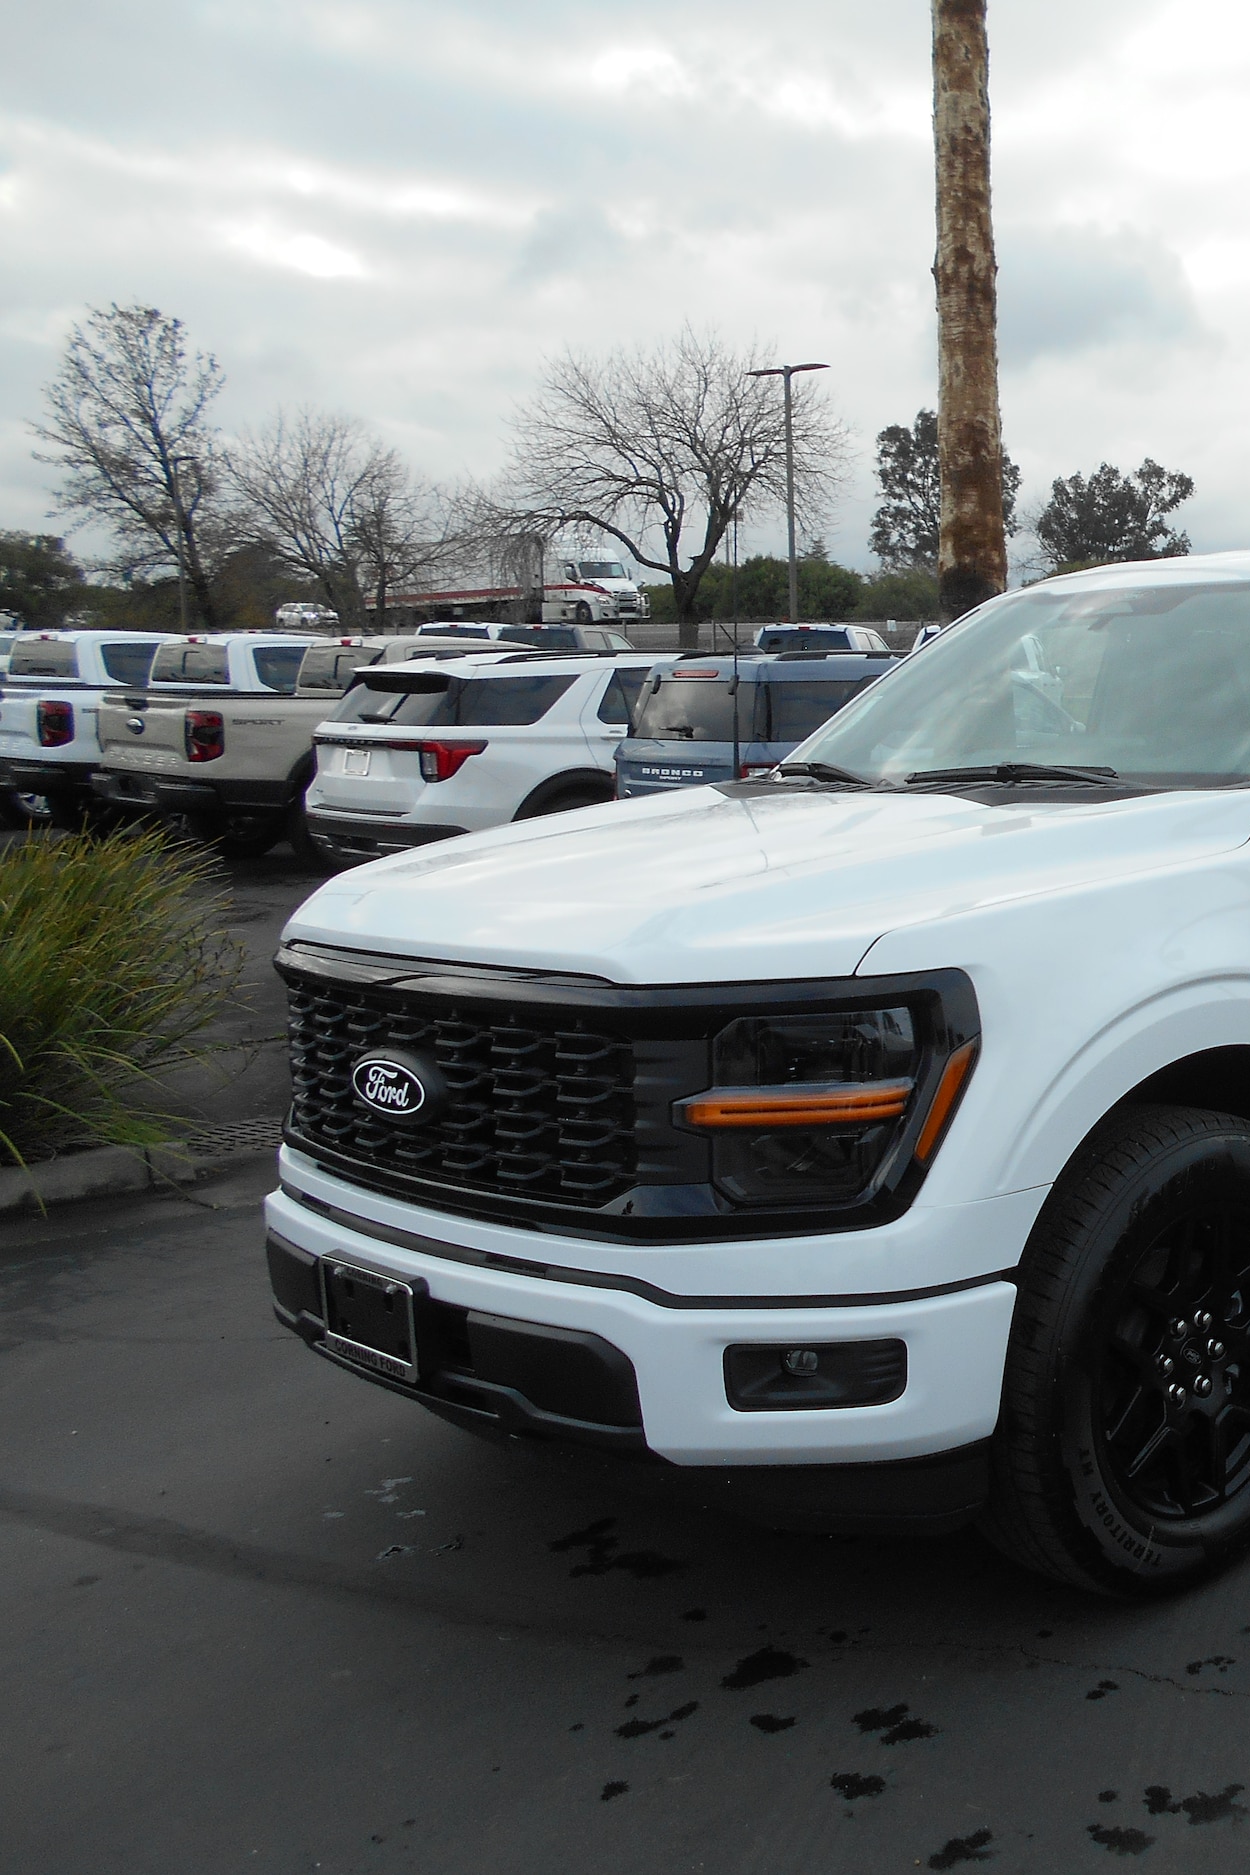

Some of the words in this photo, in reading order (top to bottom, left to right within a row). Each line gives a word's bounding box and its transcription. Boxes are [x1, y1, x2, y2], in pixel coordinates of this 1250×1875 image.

[232, 718, 285, 726] SPORT
[642, 768, 703, 777] BRONCO
[365, 1066, 410, 1108] Ford
[335, 1339, 378, 1366] CORNING
[1089, 1491, 1163, 1567] TERRITORY
